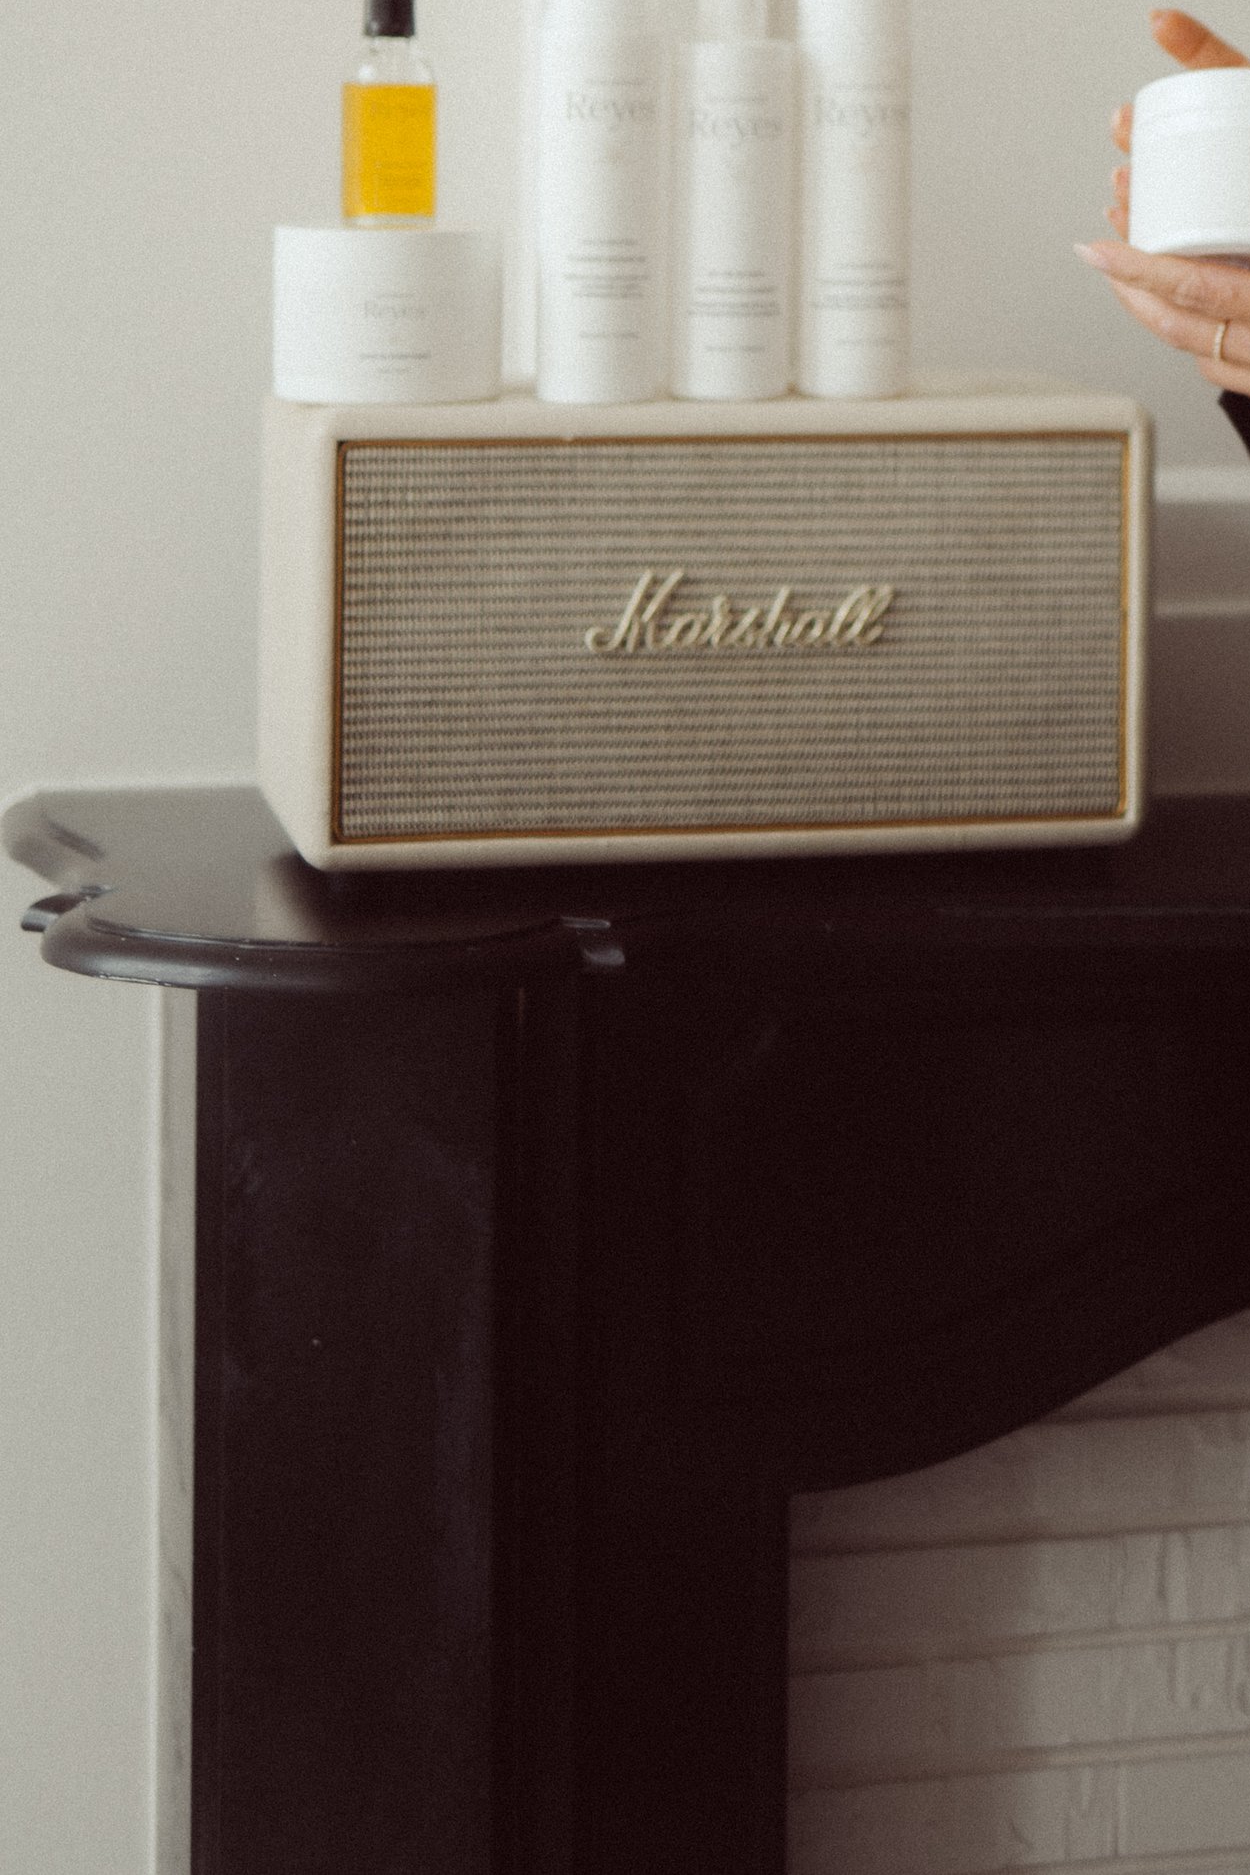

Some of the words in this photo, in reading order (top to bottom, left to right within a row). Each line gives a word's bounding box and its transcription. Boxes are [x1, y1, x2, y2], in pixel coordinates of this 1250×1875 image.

[565, 91, 656, 130] Reyes
[690, 110, 782, 147] Reyes
[584, 568, 895, 653] Marshall
